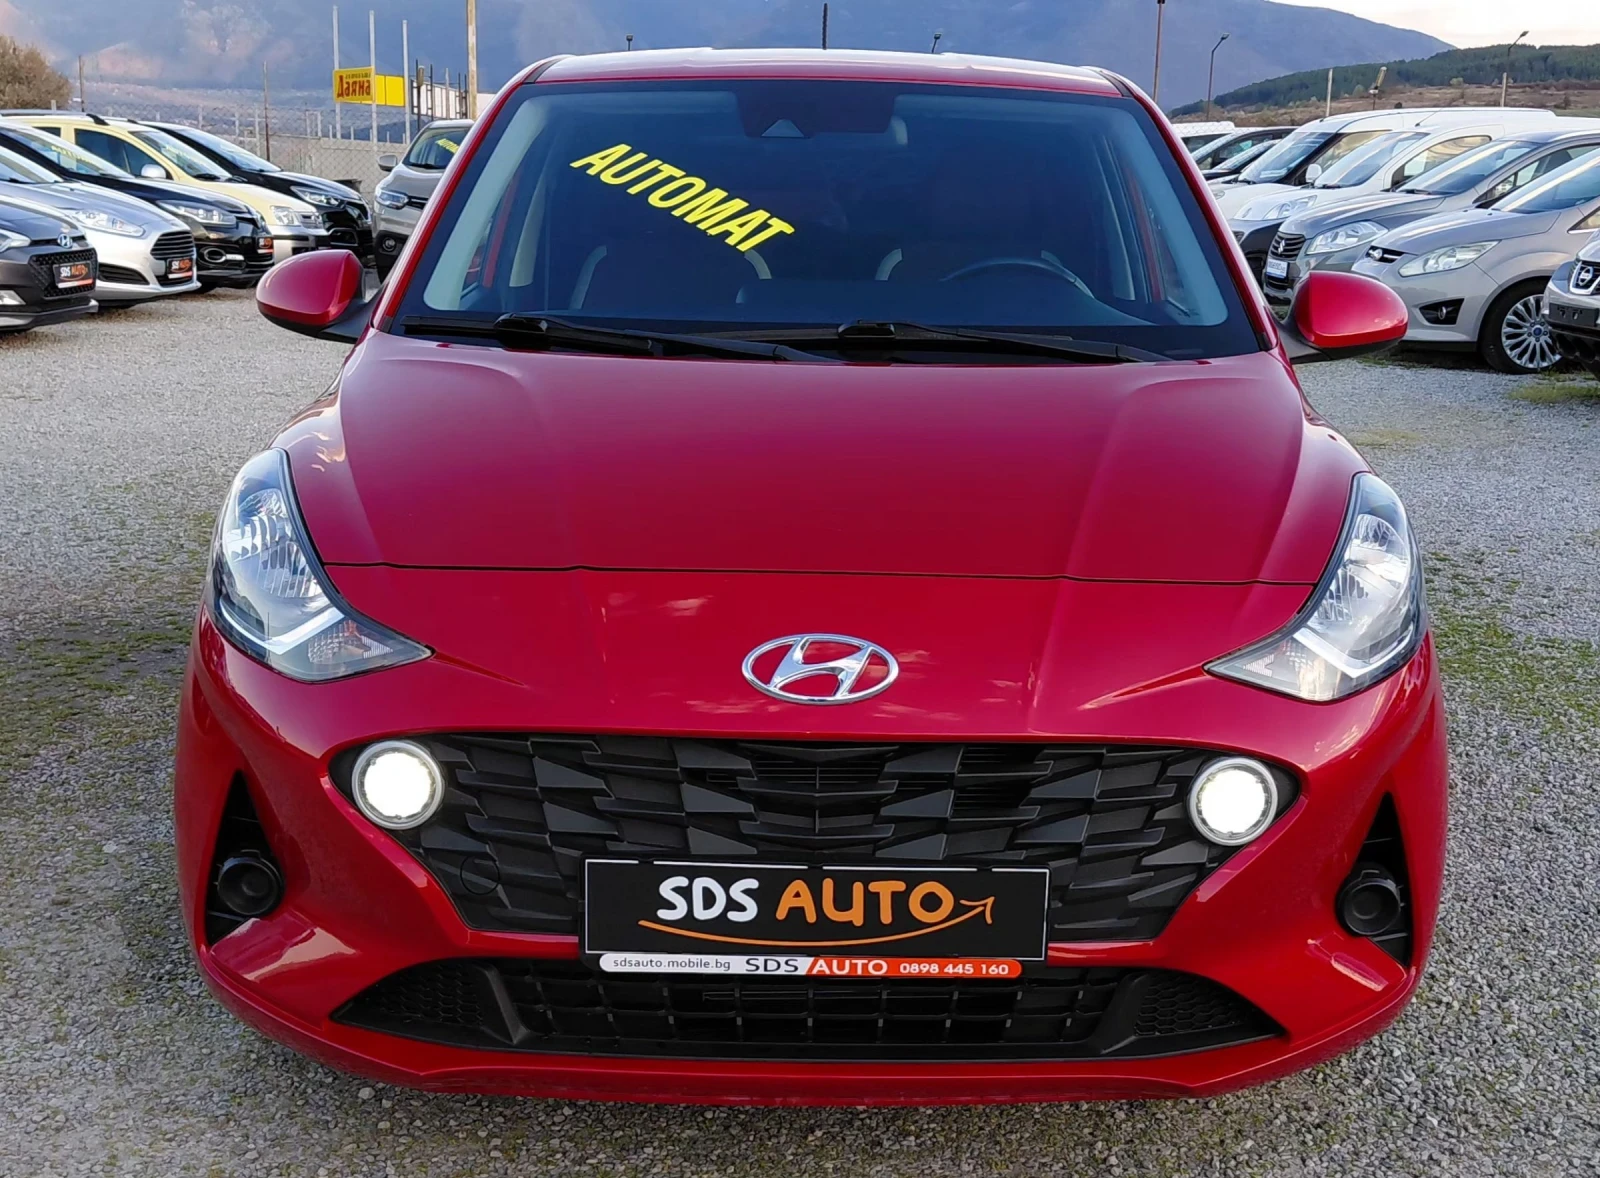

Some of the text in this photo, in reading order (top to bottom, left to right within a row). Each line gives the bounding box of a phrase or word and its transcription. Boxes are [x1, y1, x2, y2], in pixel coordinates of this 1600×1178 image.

[337, 75, 371, 98] Даяна
[569, 144, 795, 252] AUTOMAT
[657, 876, 954, 927] SDS AUTO
[613, 957, 731, 972] sdsauto.mobile.bg
[900, 962, 939, 975] 0898
[944, 963, 974, 975] 445
[981, 963, 1009, 975] 160
